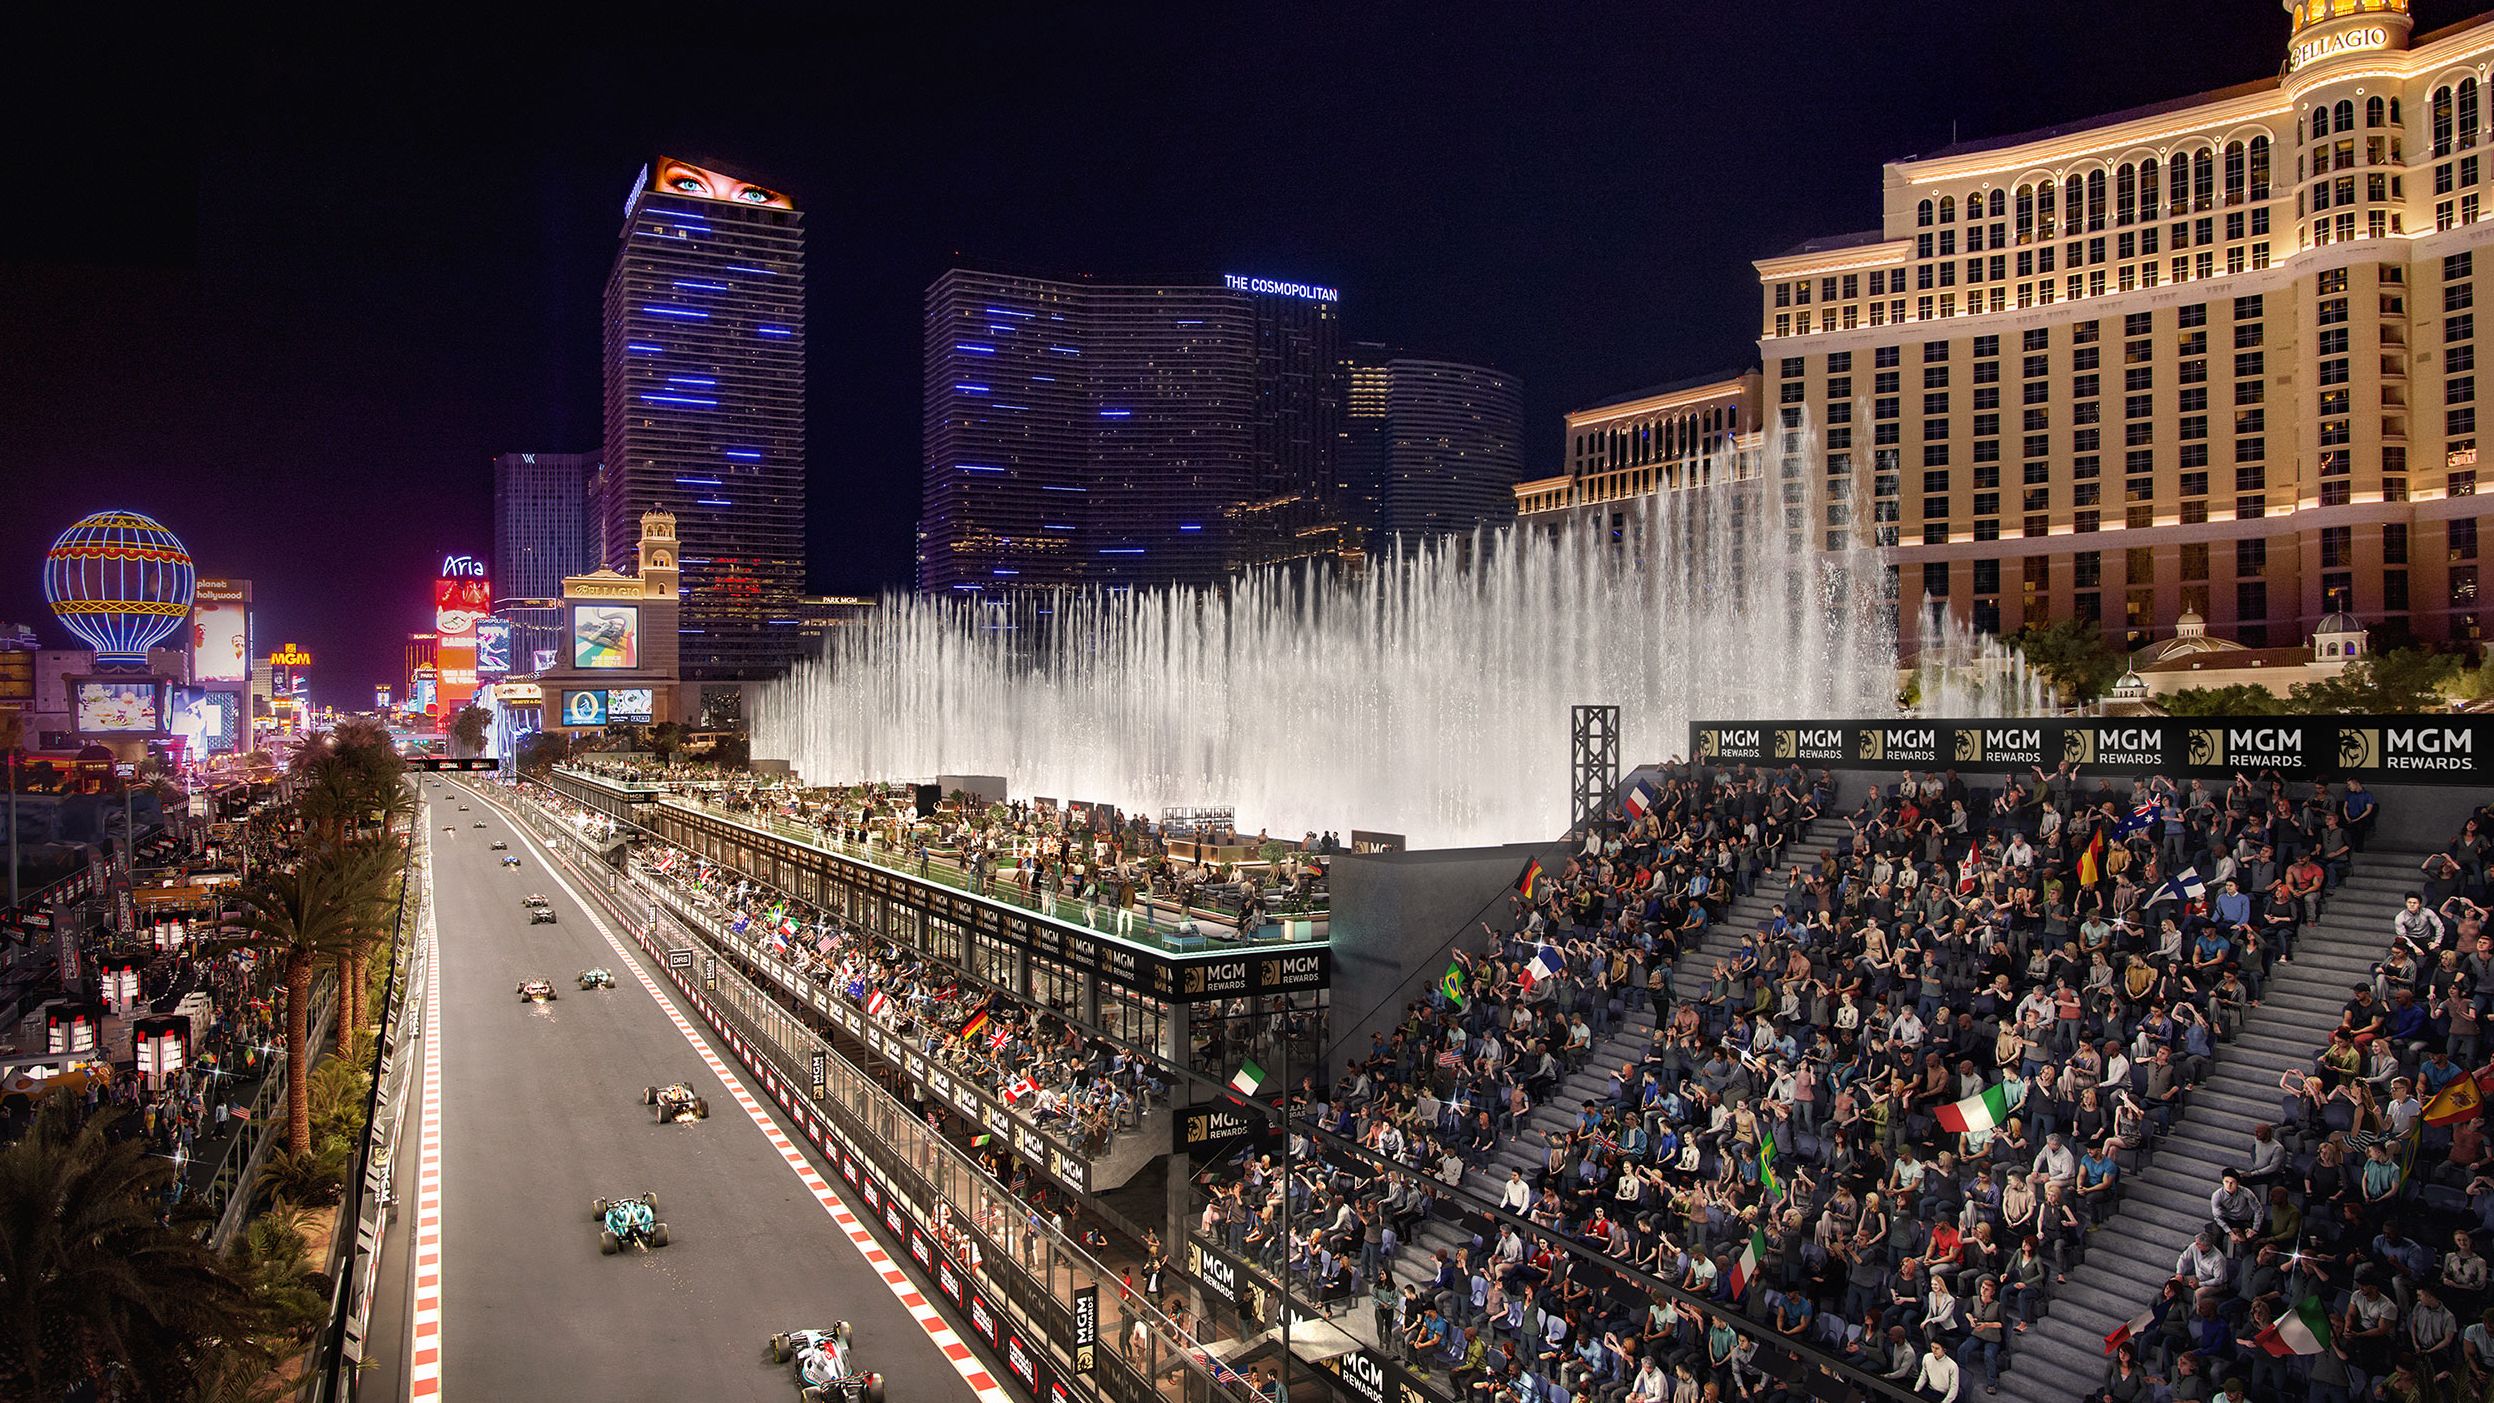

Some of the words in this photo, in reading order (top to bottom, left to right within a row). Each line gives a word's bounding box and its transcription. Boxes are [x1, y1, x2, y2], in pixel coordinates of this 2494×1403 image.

[2290, 28, 2387, 71] BELLAGIO
[1225, 275, 1248, 290] THE
[1252, 279, 1338, 302] COSMOPOLITAN
[442, 555, 484, 577] Aria
[196, 580, 227, 590] planet
[575, 584, 640, 597] BELLAGIO
[196, 591, 242, 600] hollywood
[270, 653, 311, 665] MGM
[1721, 730, 1759, 747] MGM
[1800, 730, 1842, 747] MGM
[1887, 730, 1935, 748] MGM
[1986, 729, 2041, 749] MGM
[2100, 729, 2162, 750] MGM
[2230, 729, 2302, 751] MGM
[2388, 728, 2472, 753] MGM
[1721, 749, 1760, 758] REWARDS
[1800, 750, 1842, 759] REWARDS
[1887, 751, 1935, 761] REWARDS
[1986, 752, 2041, 762] REWARDS
[2100, 754, 2162, 765] REWARDS
[2230, 755, 2302, 767] REWARDS
[2388, 757, 2473, 770] REWARDS
[984, 909, 998, 923] MGM
[1011, 918, 1027, 934] MGM
[1042, 927, 1059, 944] MGM
[1075, 938, 1095, 956] MGM
[1113, 951, 1135, 970] MGM
[1283, 956, 1319, 974] MGM
[1113, 967, 1135, 980] REWARDS
[1207, 963, 1245, 981] MGM
[1283, 973, 1319, 984] REWARDS
[1207, 981, 1246, 991] REWARDS
[962, 1087, 977, 1110] MGM
[991, 1108, 1008, 1132] MGM
[1210, 1113, 1247, 1129] MG
[1210, 1126, 1248, 1139] REWARDS
[1024, 1130, 1044, 1156] MGM
[1062, 1155, 1083, 1183] MGM
[1203, 1250, 1234, 1288] MGM
[1203, 1272, 1235, 1301] REWARDS
[1076, 1296, 1088, 1344] MGM
[1343, 1352, 1383, 1391] MGM
[1343, 1370, 1383, 1403] REWARDS
